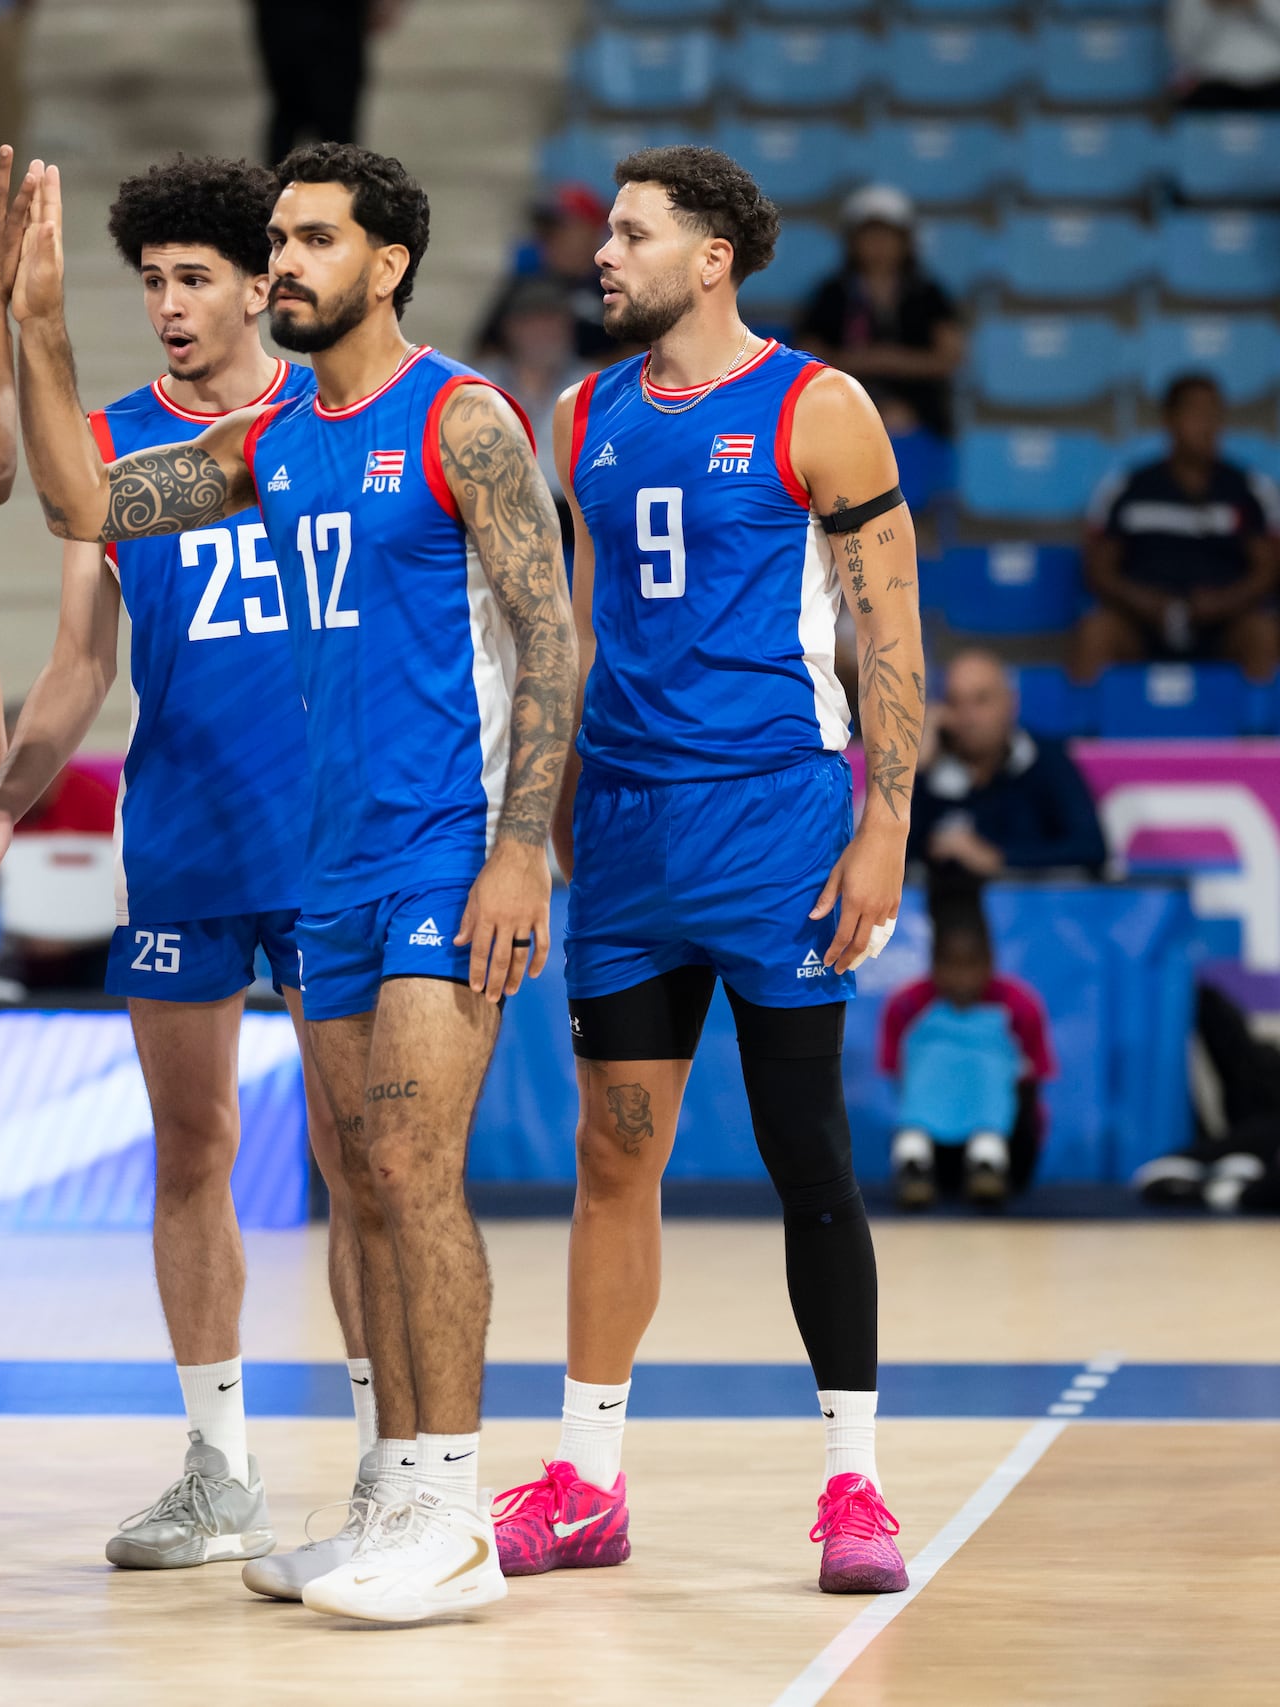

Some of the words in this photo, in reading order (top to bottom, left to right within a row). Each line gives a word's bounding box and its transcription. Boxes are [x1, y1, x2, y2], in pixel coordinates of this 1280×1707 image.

[591, 455, 619, 469] PEAK
[707, 459, 750, 474] PUR
[267, 479, 292, 493] PEAK
[361, 476, 402, 494] PUR
[636, 487, 686, 599] 9
[297, 511, 360, 631] 12
[179, 522, 289, 642] 25
[409, 933, 445, 947] PEAK
[130, 930, 182, 974] 25
[796, 965, 827, 979] PEAK
[418, 1491, 443, 1506] NIKE
